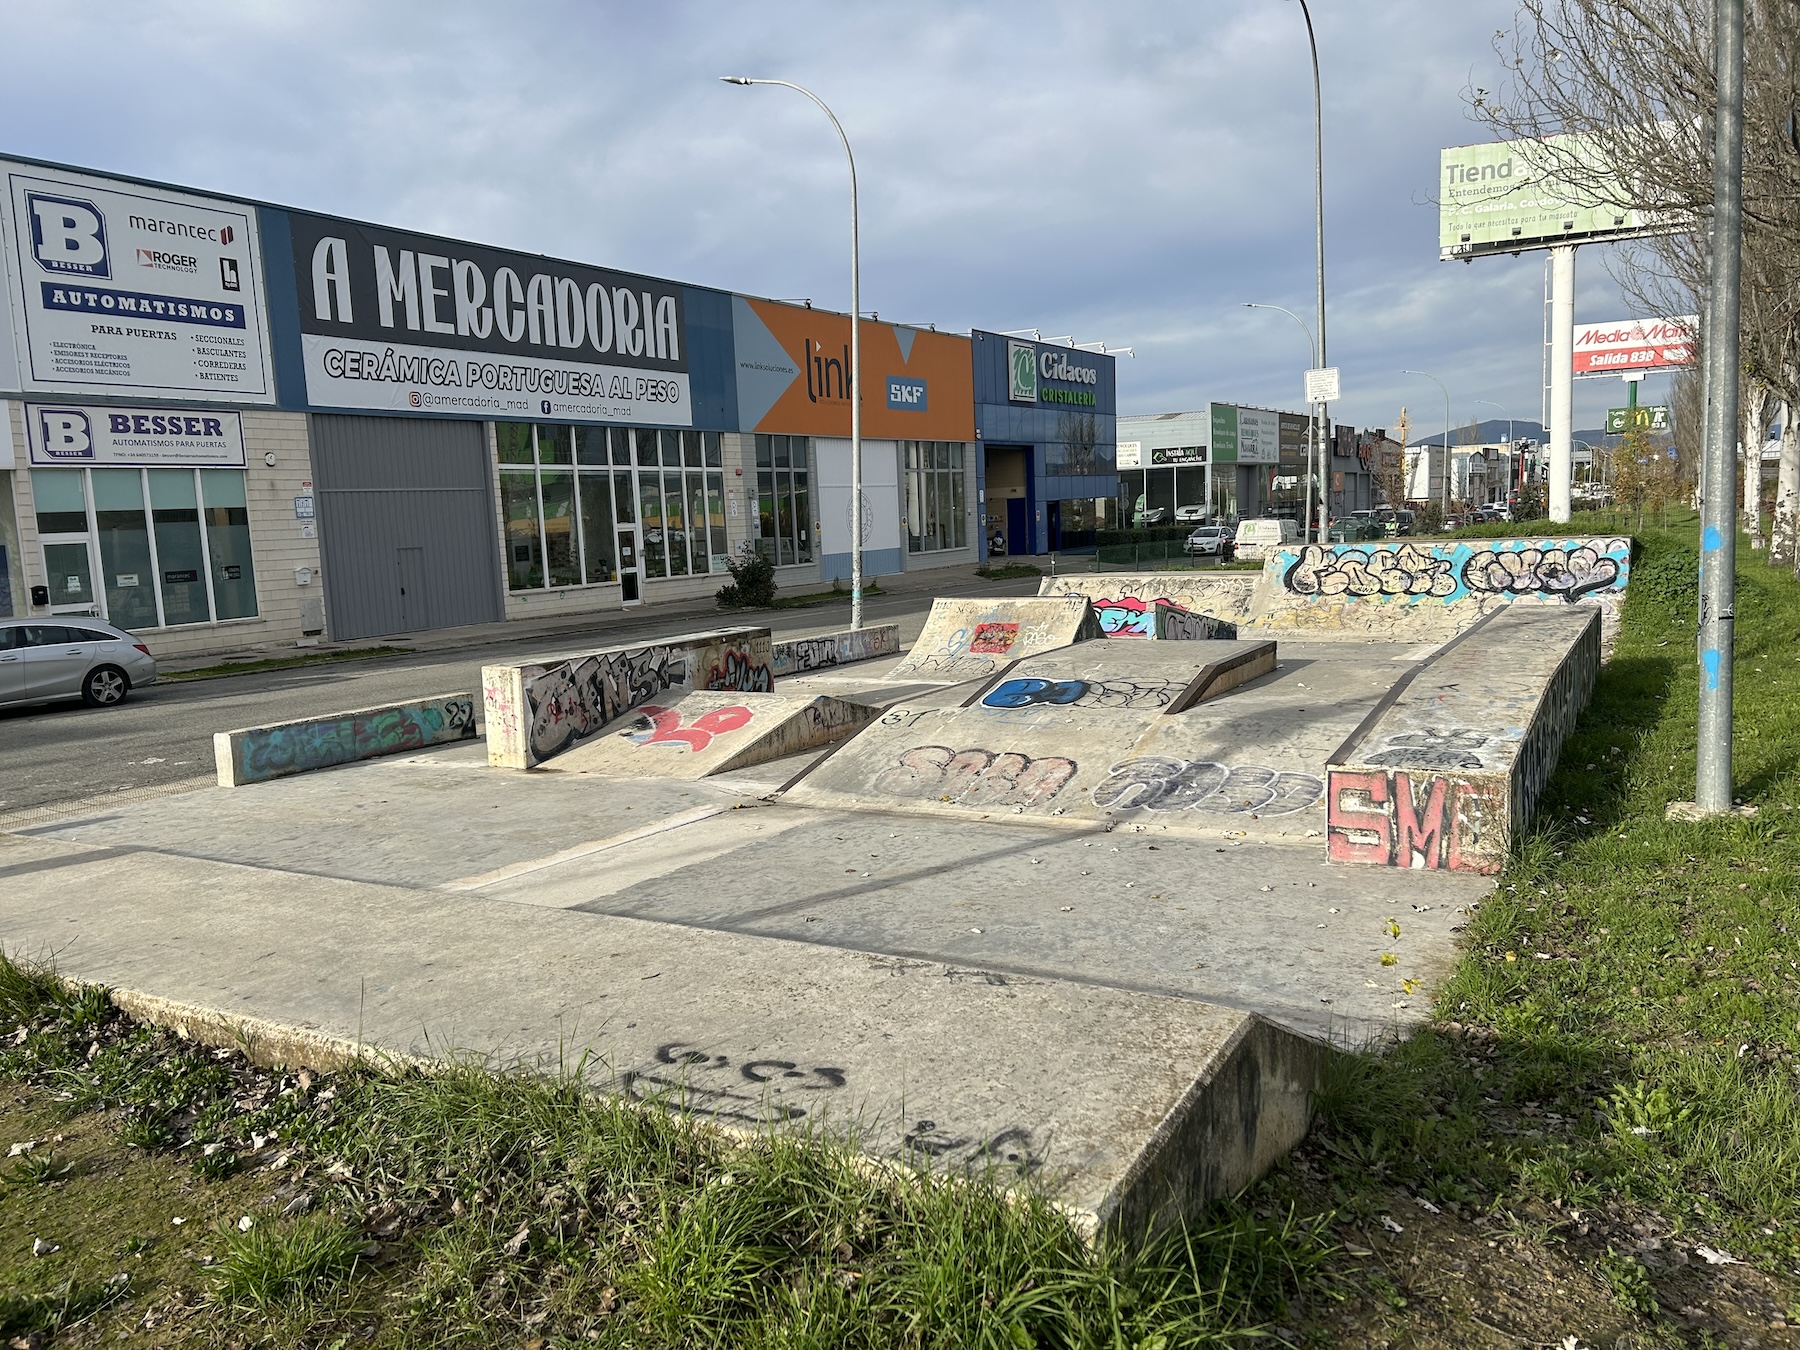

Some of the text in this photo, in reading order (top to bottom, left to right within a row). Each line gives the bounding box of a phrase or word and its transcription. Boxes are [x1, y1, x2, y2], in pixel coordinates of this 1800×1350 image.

[1449, 183, 1515, 198] Entendemos
[1474, 200, 1517, 214] Galaria,
[129, 215, 218, 242] marantec
[1449, 223, 1463, 232] Todo
[1465, 222, 1472, 231] lo
[1474, 222, 1485, 231] que
[1488, 216, 1518, 227] necesitas
[1521, 216, 1536, 227] para
[1539, 213, 1547, 222] tu
[51, 261, 93, 272] BESSER
[153, 251, 198, 269] ROGER
[154, 262, 198, 274] TECHNOLOGY
[311, 232, 681, 362] A MERCADORIA
[52, 289, 236, 322] AUTOMATISMOS
[91, 324, 177, 341] PARA PUERTAS
[1575, 329, 1631, 346] Media
[52, 341, 97, 351] ELECTRÓNICA
[195, 334, 245, 347] SECCIONALES
[90, 352, 128, 361] RECEPTORES
[196, 346, 247, 359] BASCULANTES
[1589, 353, 1628, 366] Salida
[55, 358, 131, 369] ACCESORIOS ELÉCTRICOS
[198, 359, 247, 371] CORREDERAS
[739, 360, 794, 375] www.linksoluciones.es
[1040, 351, 1097, 385] Cidacos
[56, 366, 131, 377] ACCESORIOS MECÁNICOS
[199, 372, 239, 382] BATIENTES
[323, 348, 681, 404] CERÁMICA PORTUGUESA AL PESO
[890, 383, 924, 404] SKF
[1042, 387, 1097, 407] CRISTALERÍA
[423, 392, 632, 417] @amercadoria_mad amercadoria_mad
[108, 413, 223, 437] BESSER
[112, 438, 175, 448] AUTOMATISMOS
[196, 441, 227, 449] PUERTAS
